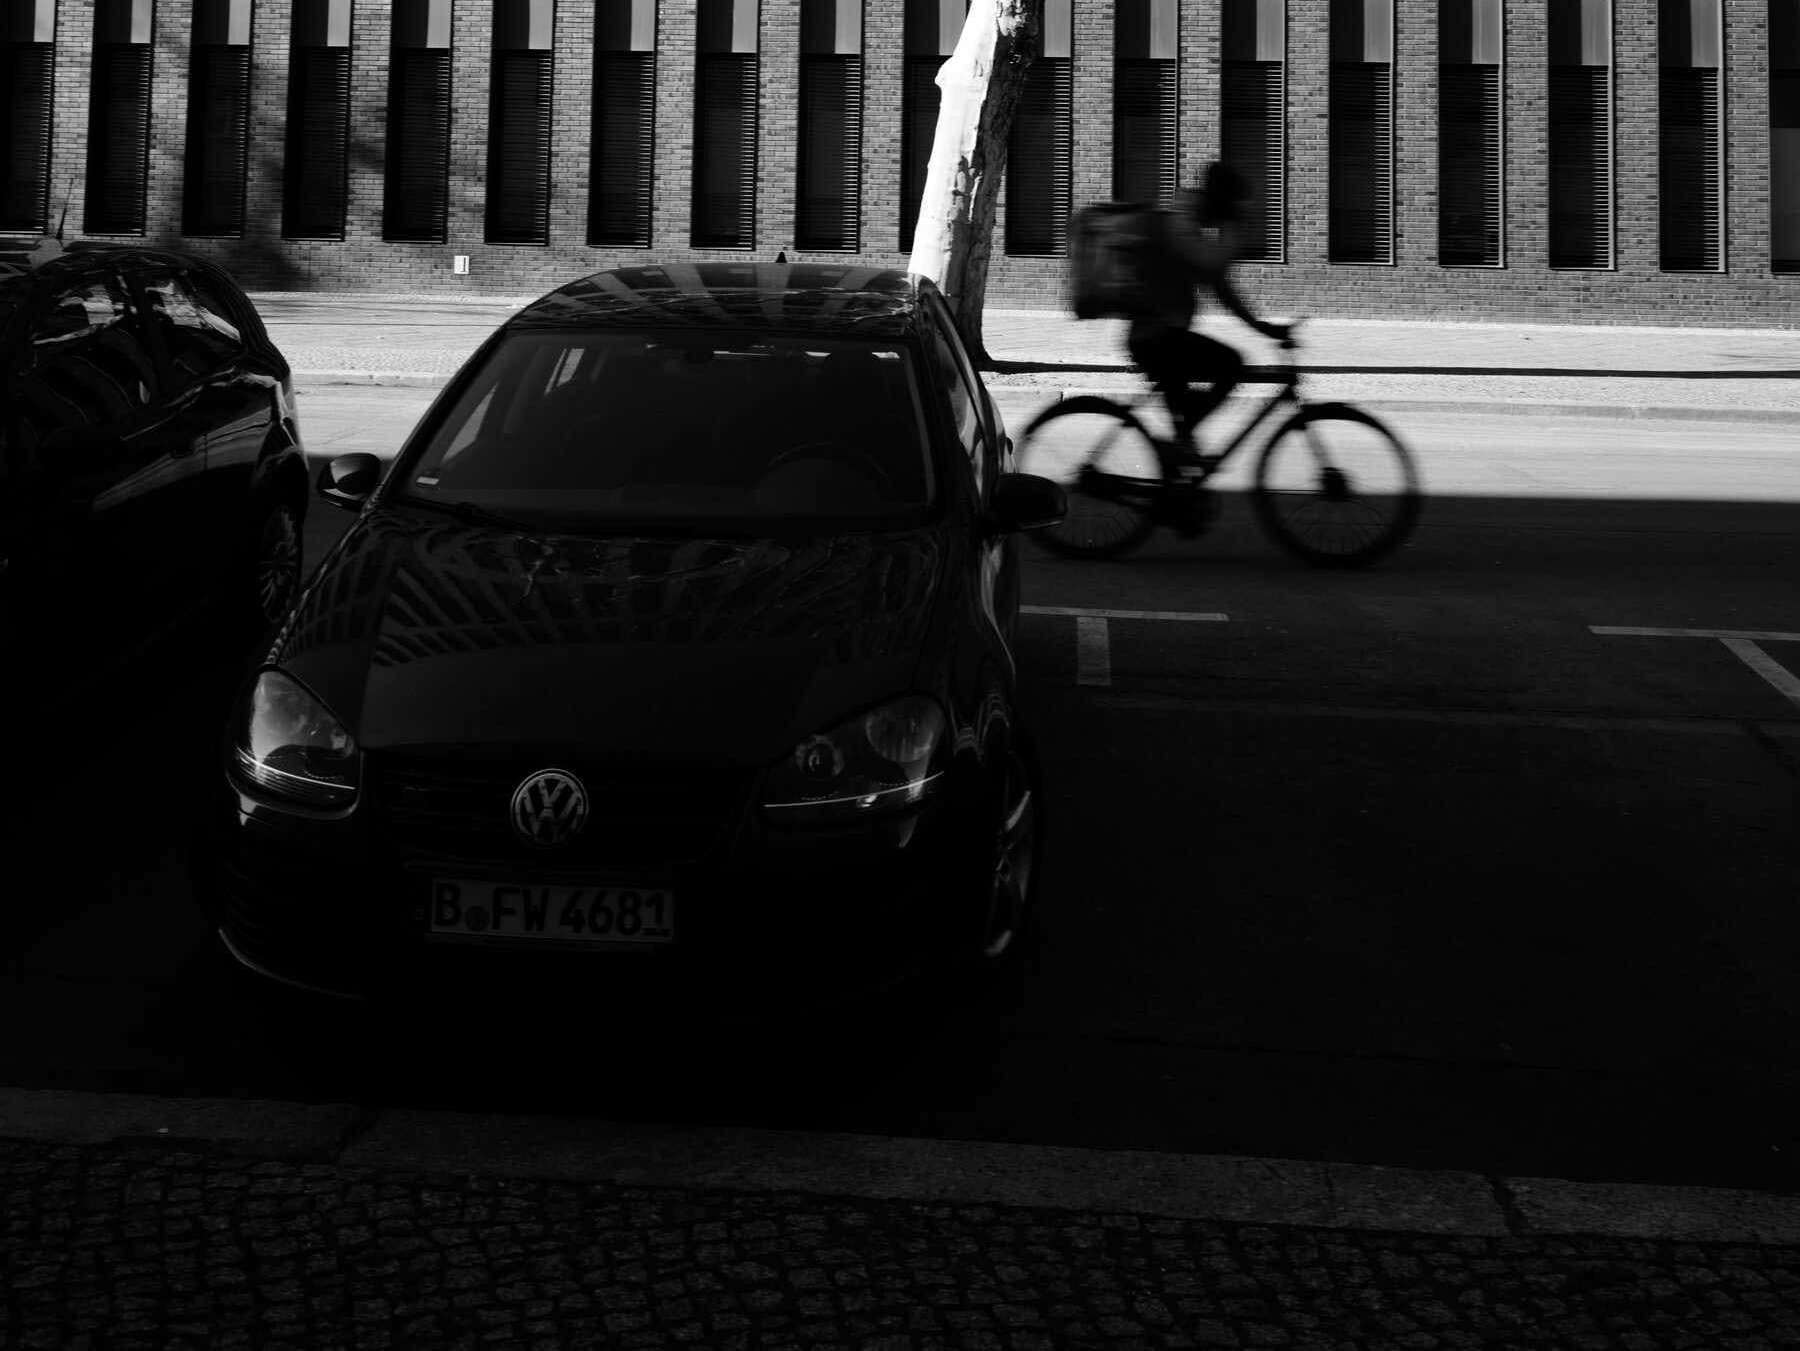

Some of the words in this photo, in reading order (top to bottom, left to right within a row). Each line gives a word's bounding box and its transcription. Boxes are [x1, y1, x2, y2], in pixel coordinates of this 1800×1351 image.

[513, 772, 585, 845] VW
[436, 883, 460, 926] B
[493, 887, 549, 932] FW
[559, 890, 670, 937] 4681
